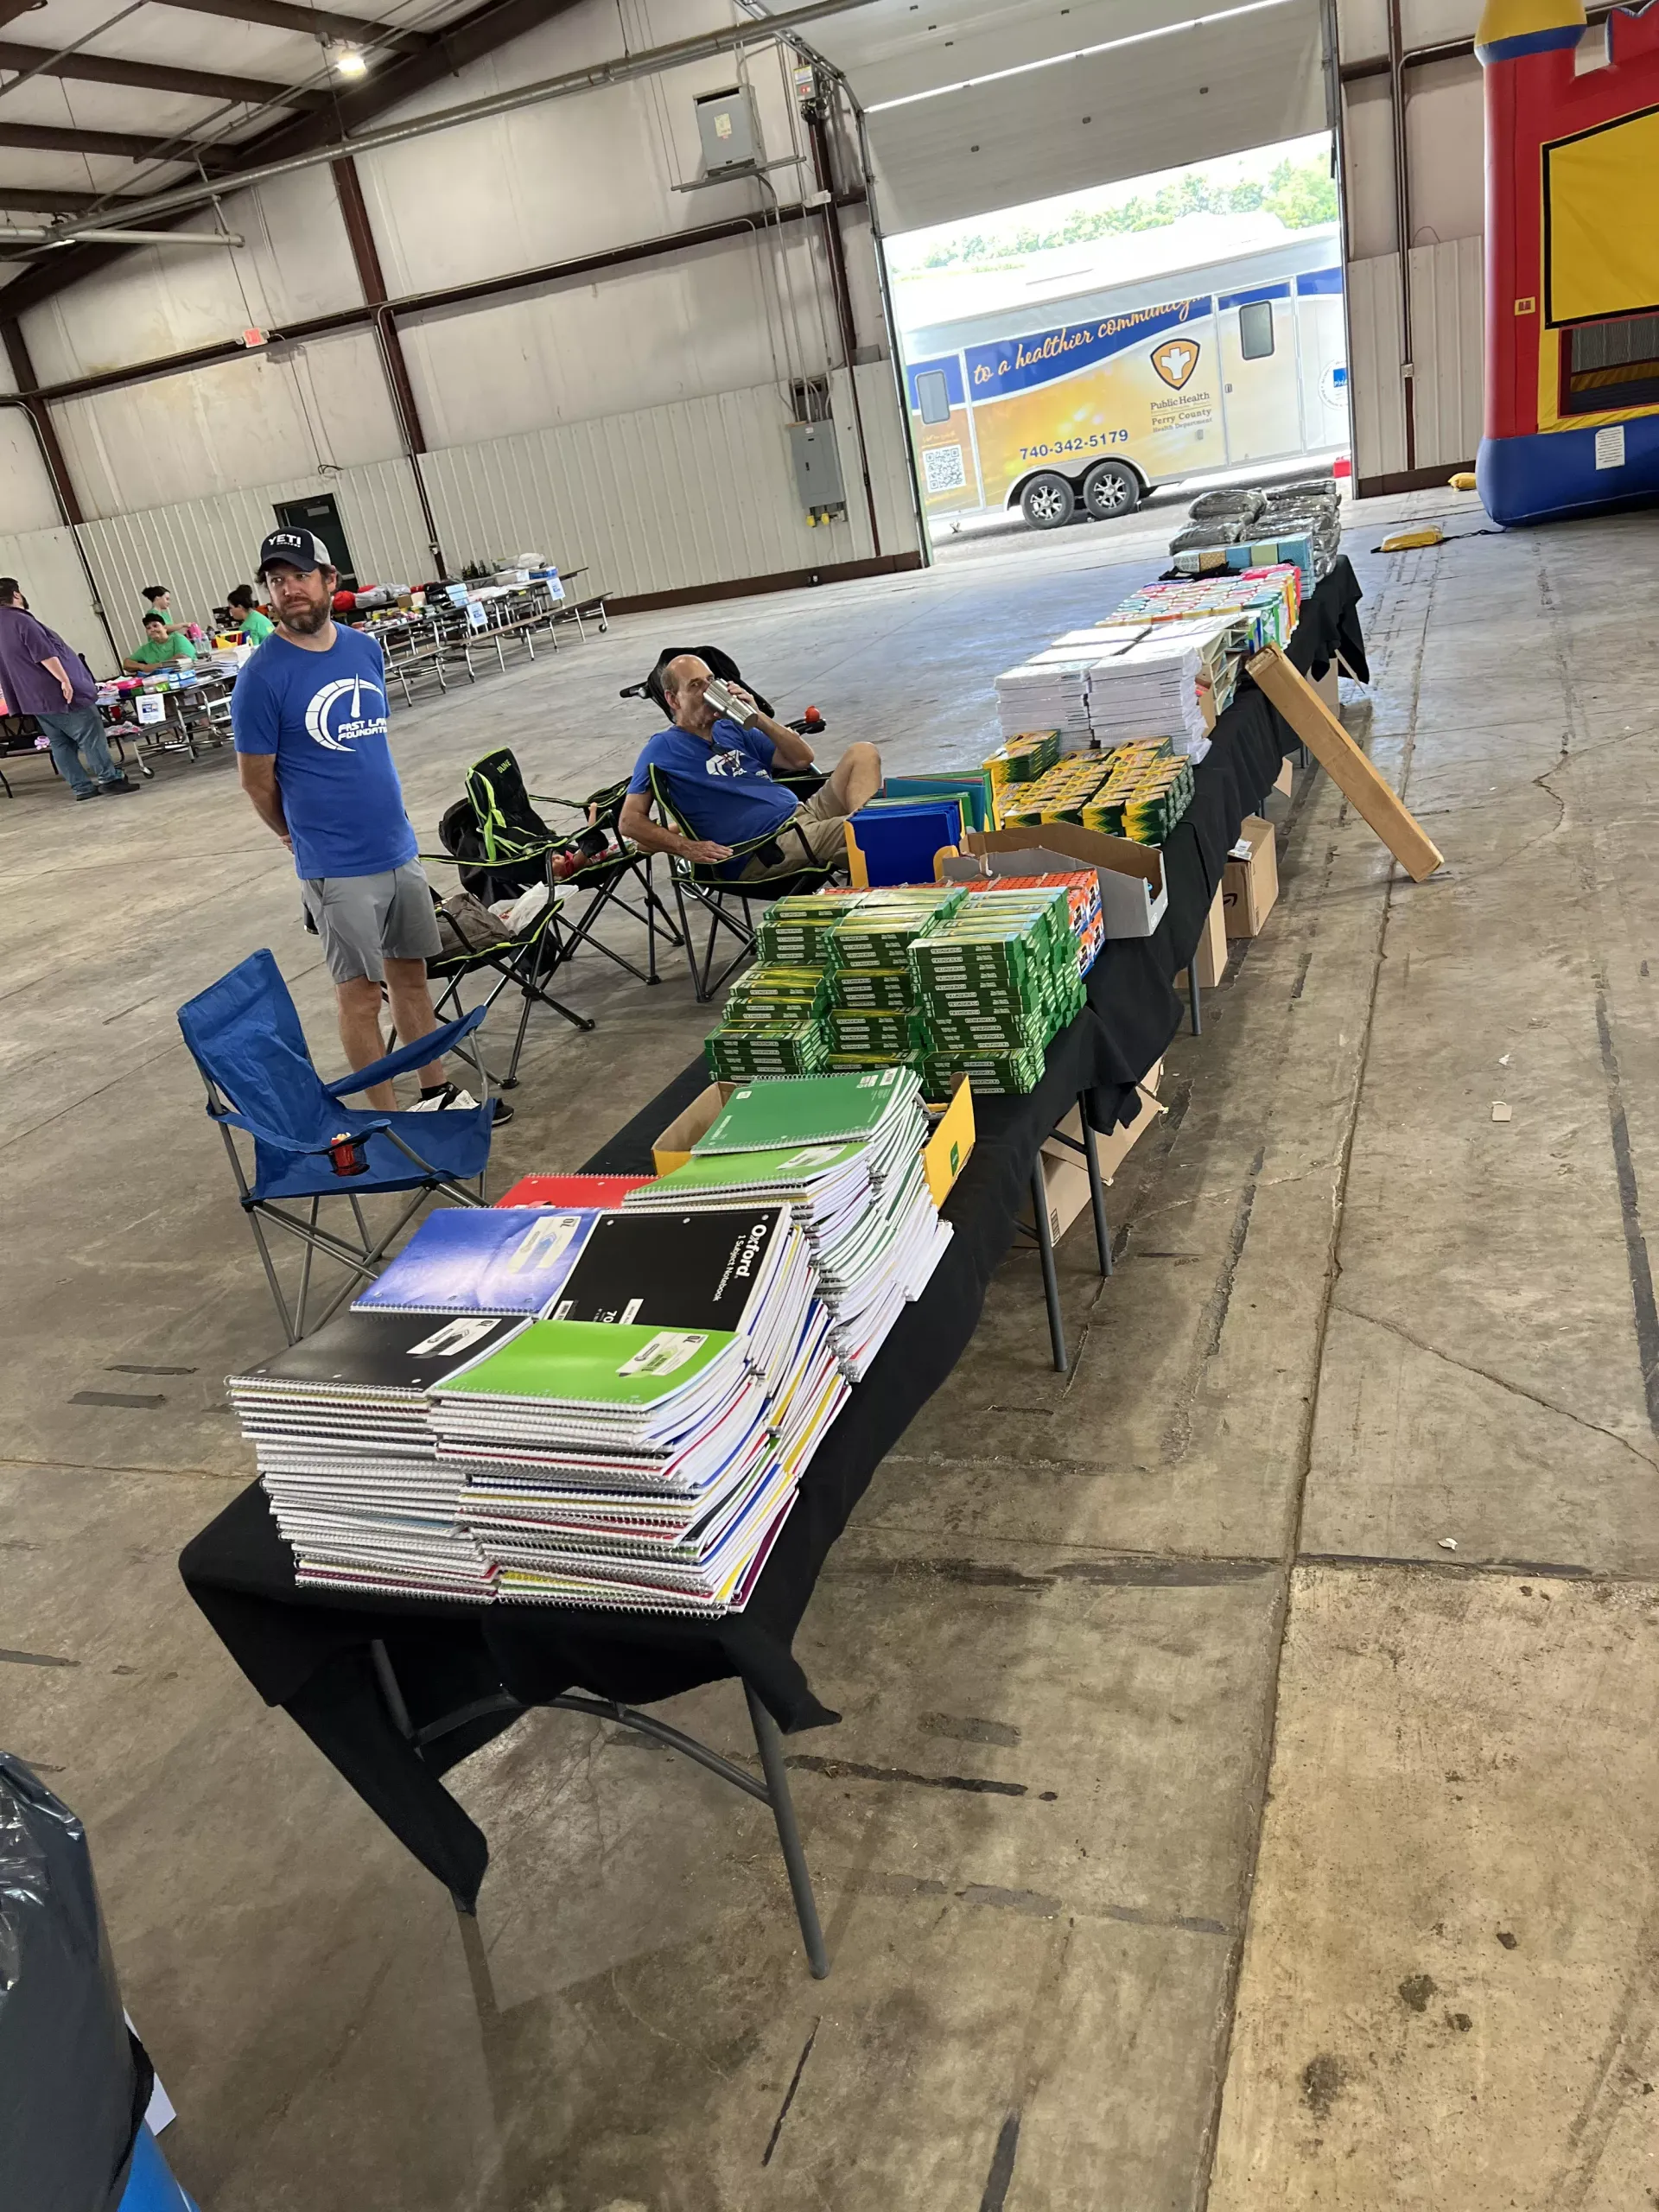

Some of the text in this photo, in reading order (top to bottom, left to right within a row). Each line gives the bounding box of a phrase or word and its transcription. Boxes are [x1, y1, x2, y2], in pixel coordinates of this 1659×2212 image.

[974, 364, 993, 385] to
[998, 359, 1011, 375] a
[1015, 327, 1094, 370] healthier
[1150, 398, 1178, 410] Public
[1179, 392, 1211, 405] Health
[1152, 409, 1212, 426] Perry County
[1020, 429, 1128, 460] 740-342-5179
[268, 533, 302, 546] YETI
[338, 717, 387, 734] FAST LAN
[727, 1240, 745, 1267] Subject
[735, 1224, 766, 1278] Oxford
[712, 1267, 734, 1301] Notebook
[603, 1310, 618, 1323] 70
[683, 1335, 702, 1344] 70
